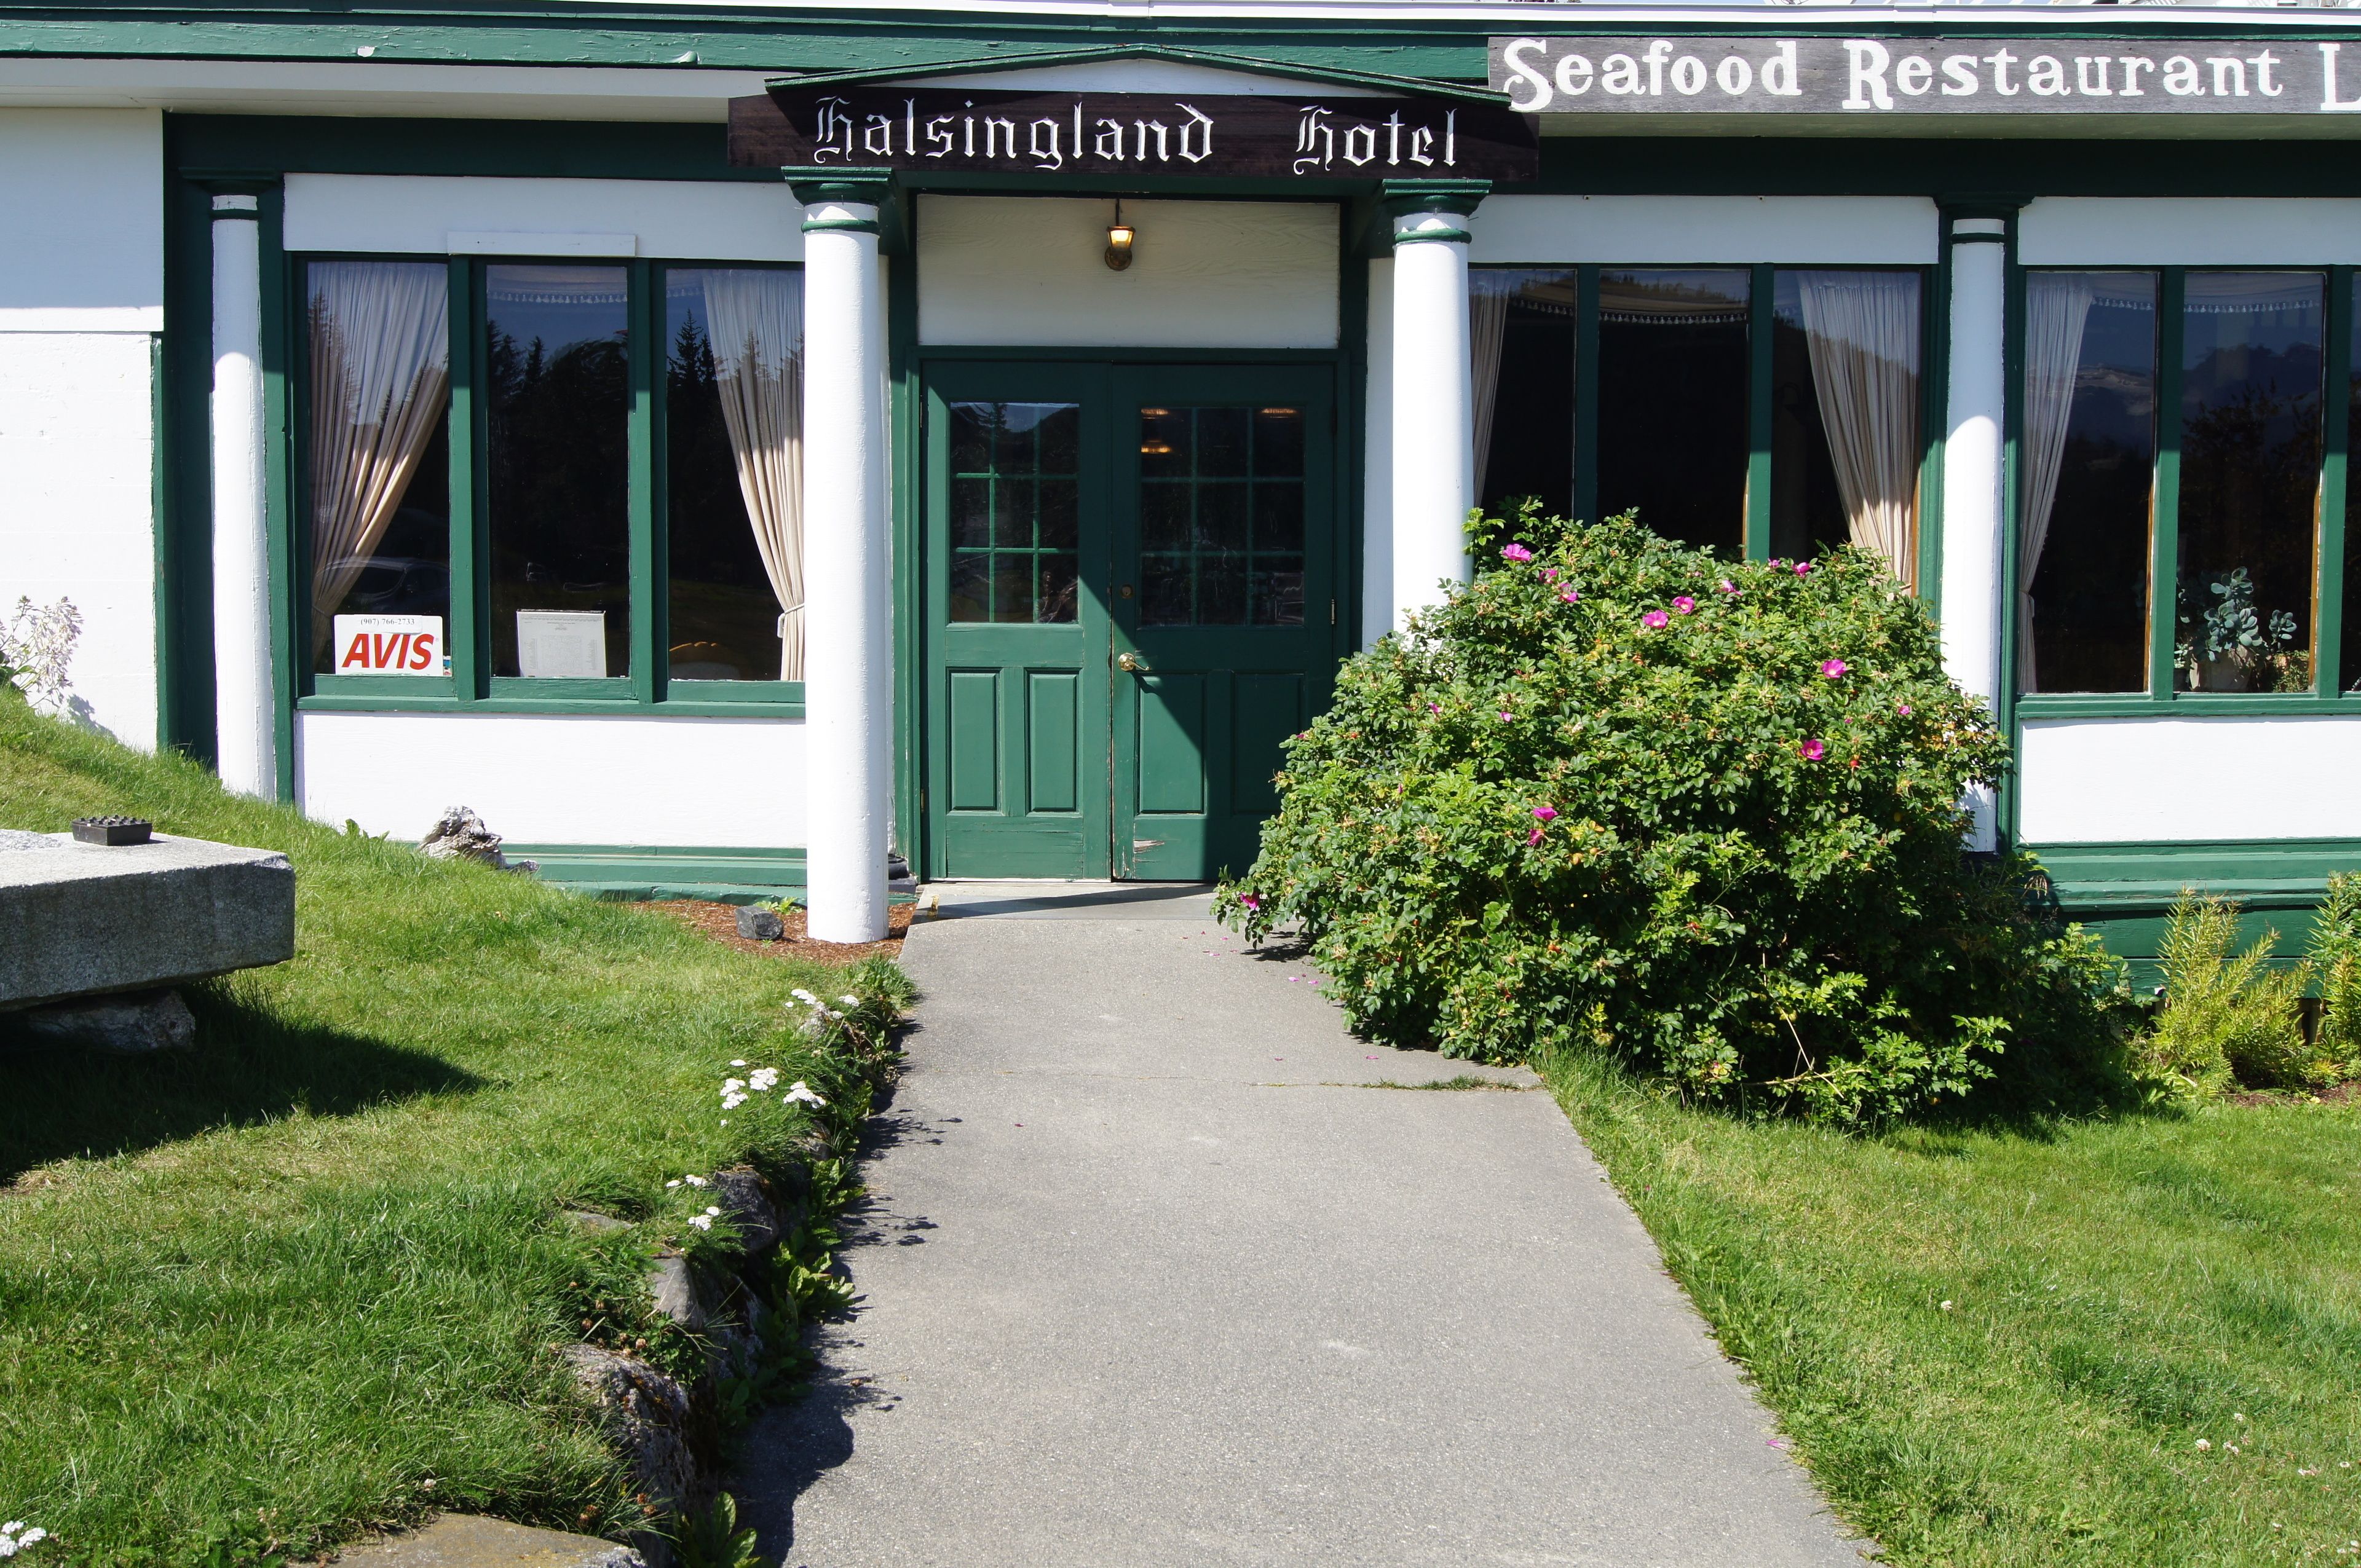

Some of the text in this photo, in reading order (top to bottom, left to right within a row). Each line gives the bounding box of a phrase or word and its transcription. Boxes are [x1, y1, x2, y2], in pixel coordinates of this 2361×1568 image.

[1503, 38, 1802, 112] Seafood
[1842, 39, 2284, 110] Restaurant
[814, 95, 1458, 175] Halsingland Hotel
[342, 633, 434, 670] AVIS
